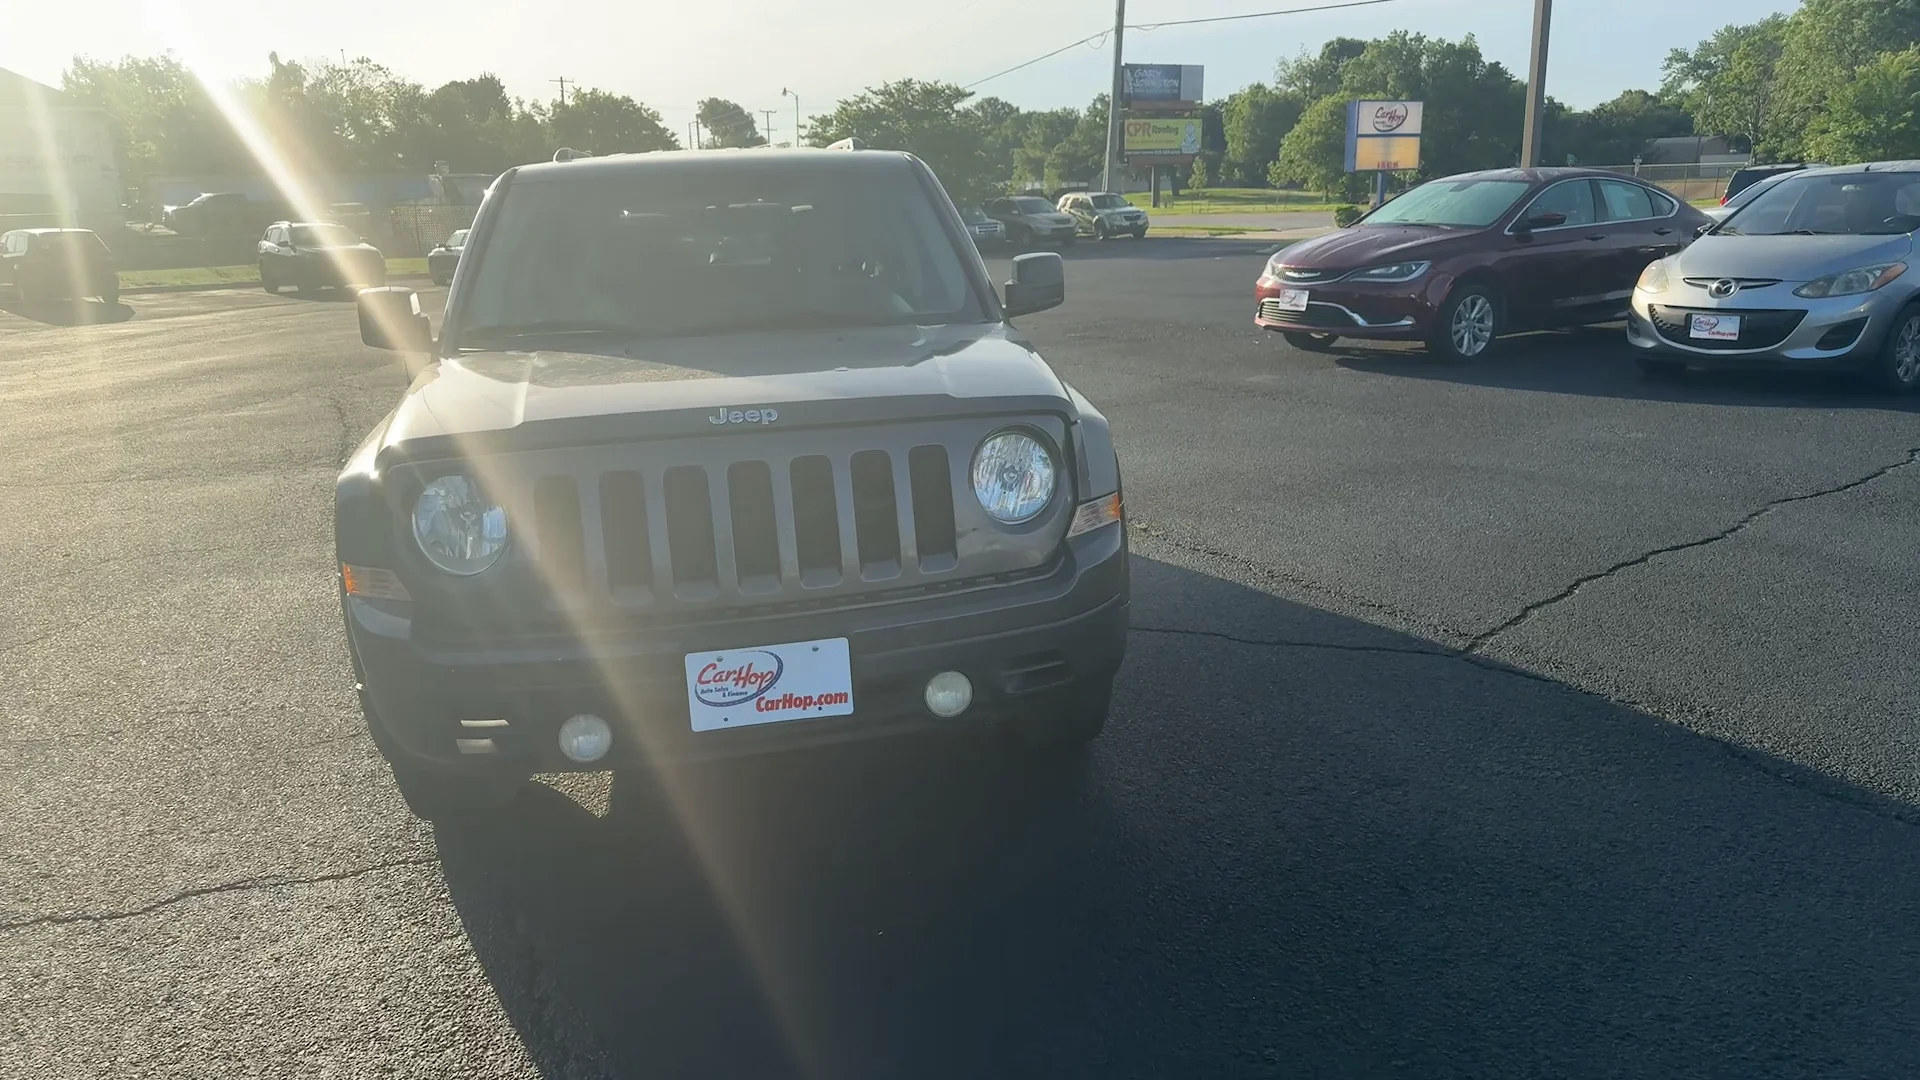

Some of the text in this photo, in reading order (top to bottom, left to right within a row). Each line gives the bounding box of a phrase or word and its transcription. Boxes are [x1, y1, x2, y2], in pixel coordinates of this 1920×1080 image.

[1127, 122, 1179, 137] CPR Roofing
[709, 407, 778, 425] Jeep
[756, 692, 849, 713] CarHop.com
